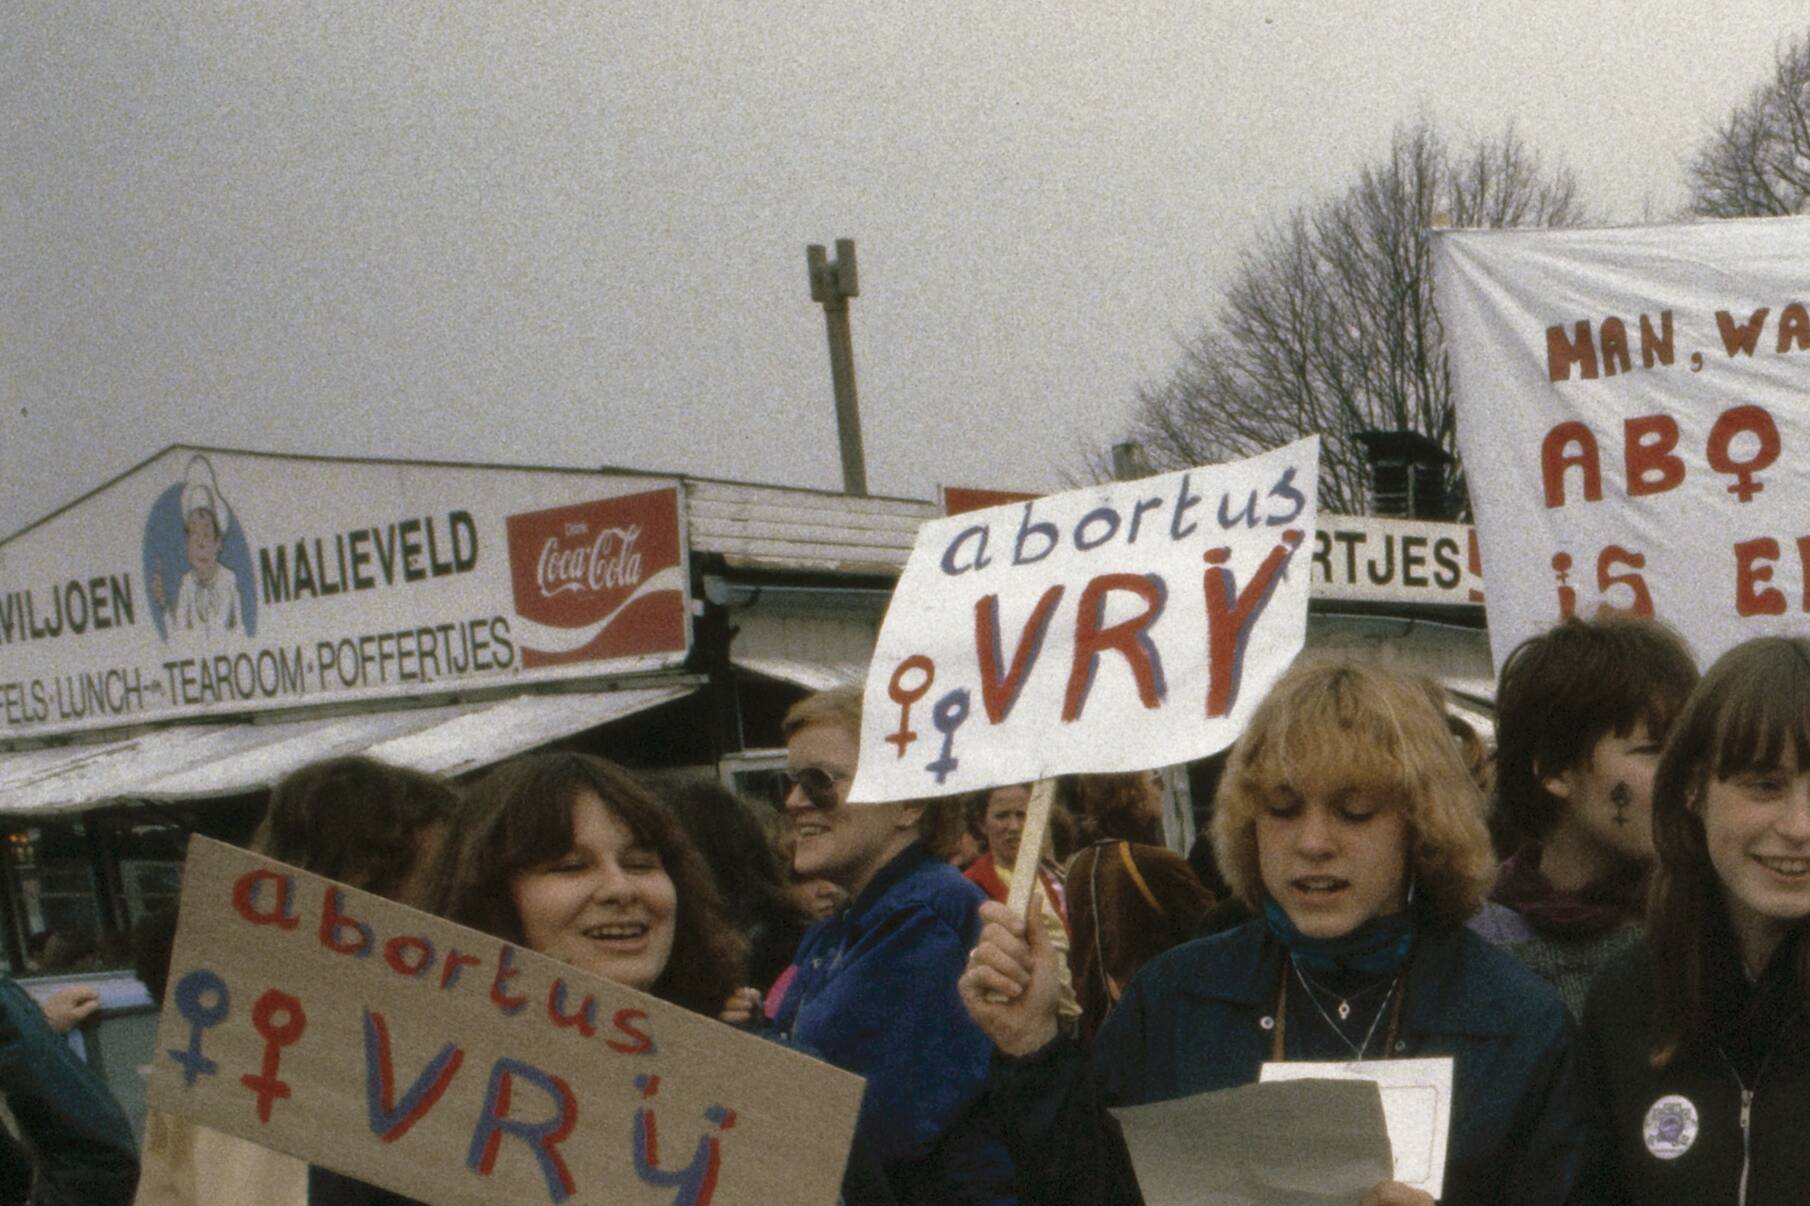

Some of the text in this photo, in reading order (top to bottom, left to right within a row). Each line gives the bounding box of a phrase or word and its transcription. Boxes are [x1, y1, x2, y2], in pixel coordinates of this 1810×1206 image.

[259, 509, 479, 605] MALIEVELD
[537, 523, 643, 597] Coca-Cola
[939, 465, 1307, 577] abortus
[162, 645, 306, 706] TEAROOM
[231, 867, 659, 1056] abortus
